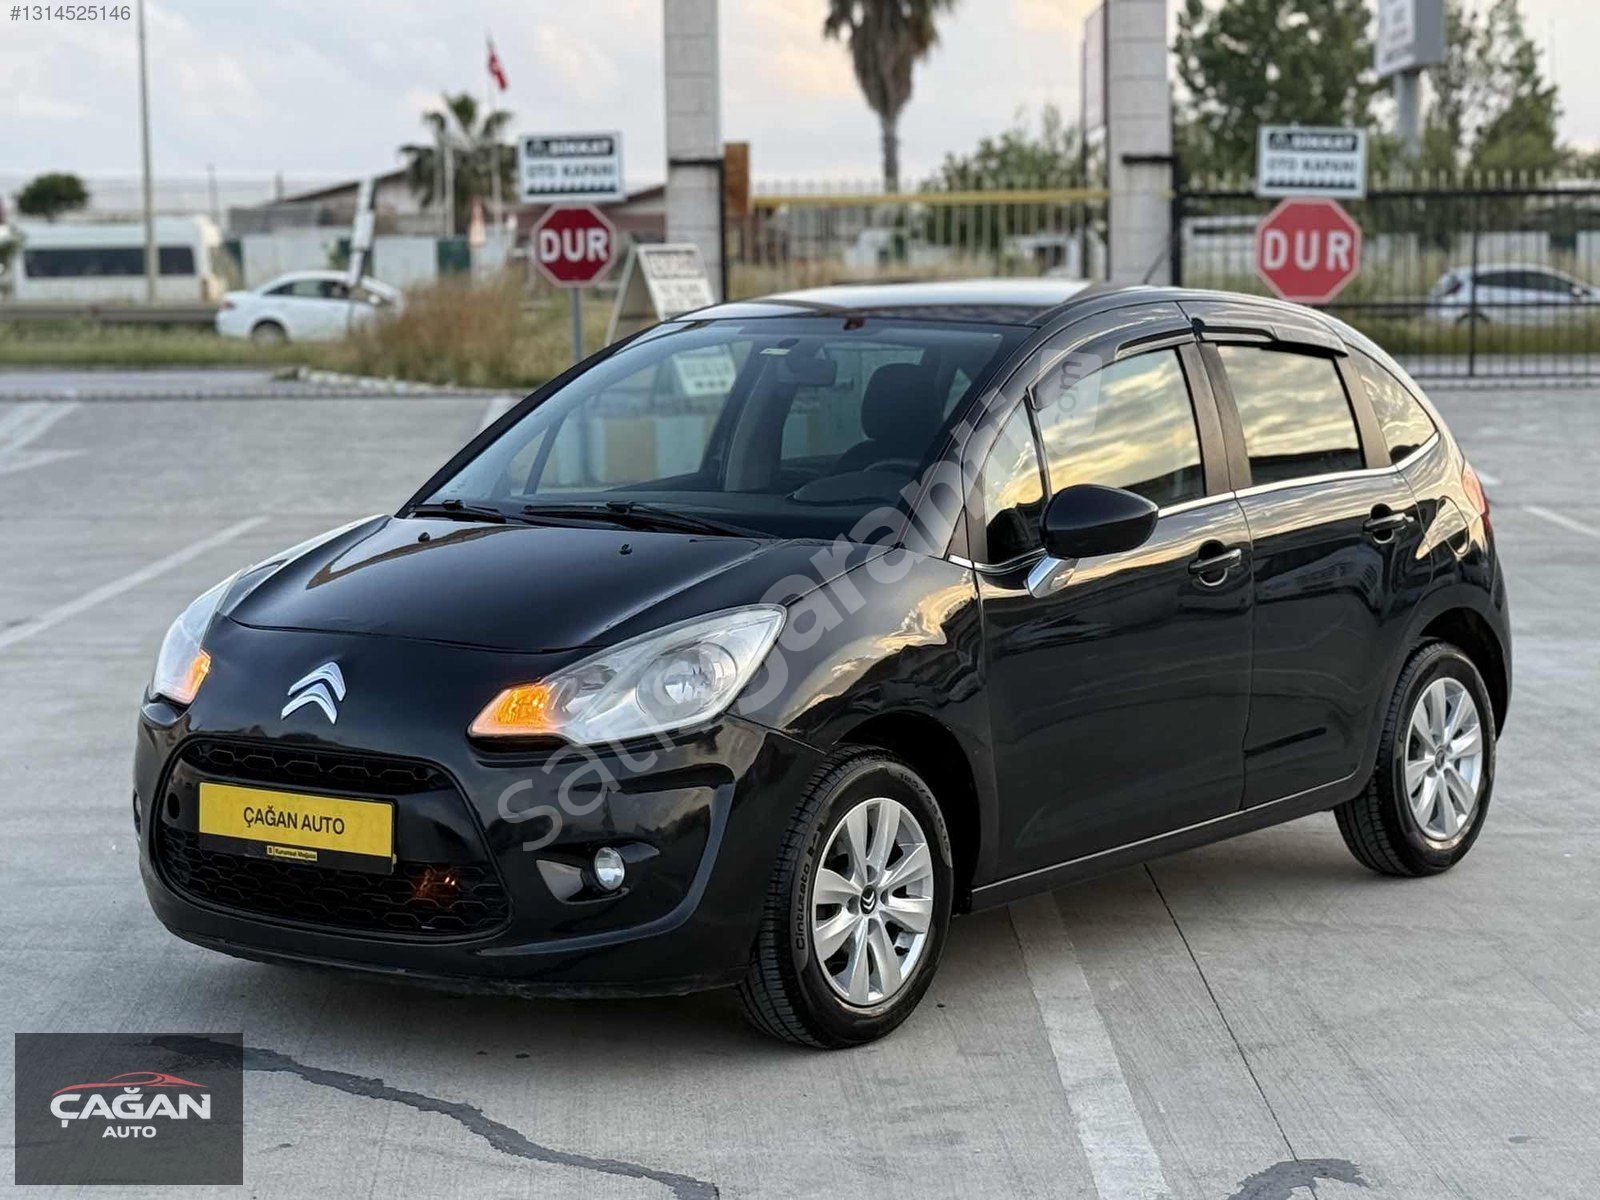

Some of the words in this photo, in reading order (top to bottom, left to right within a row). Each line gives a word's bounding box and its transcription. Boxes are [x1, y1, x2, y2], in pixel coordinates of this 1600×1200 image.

[539, 228, 609, 263] DUR
[1263, 229, 1352, 271] DUR
[243, 804, 298, 829] ÇAĞAN
[300, 813, 345, 835] AUTO
